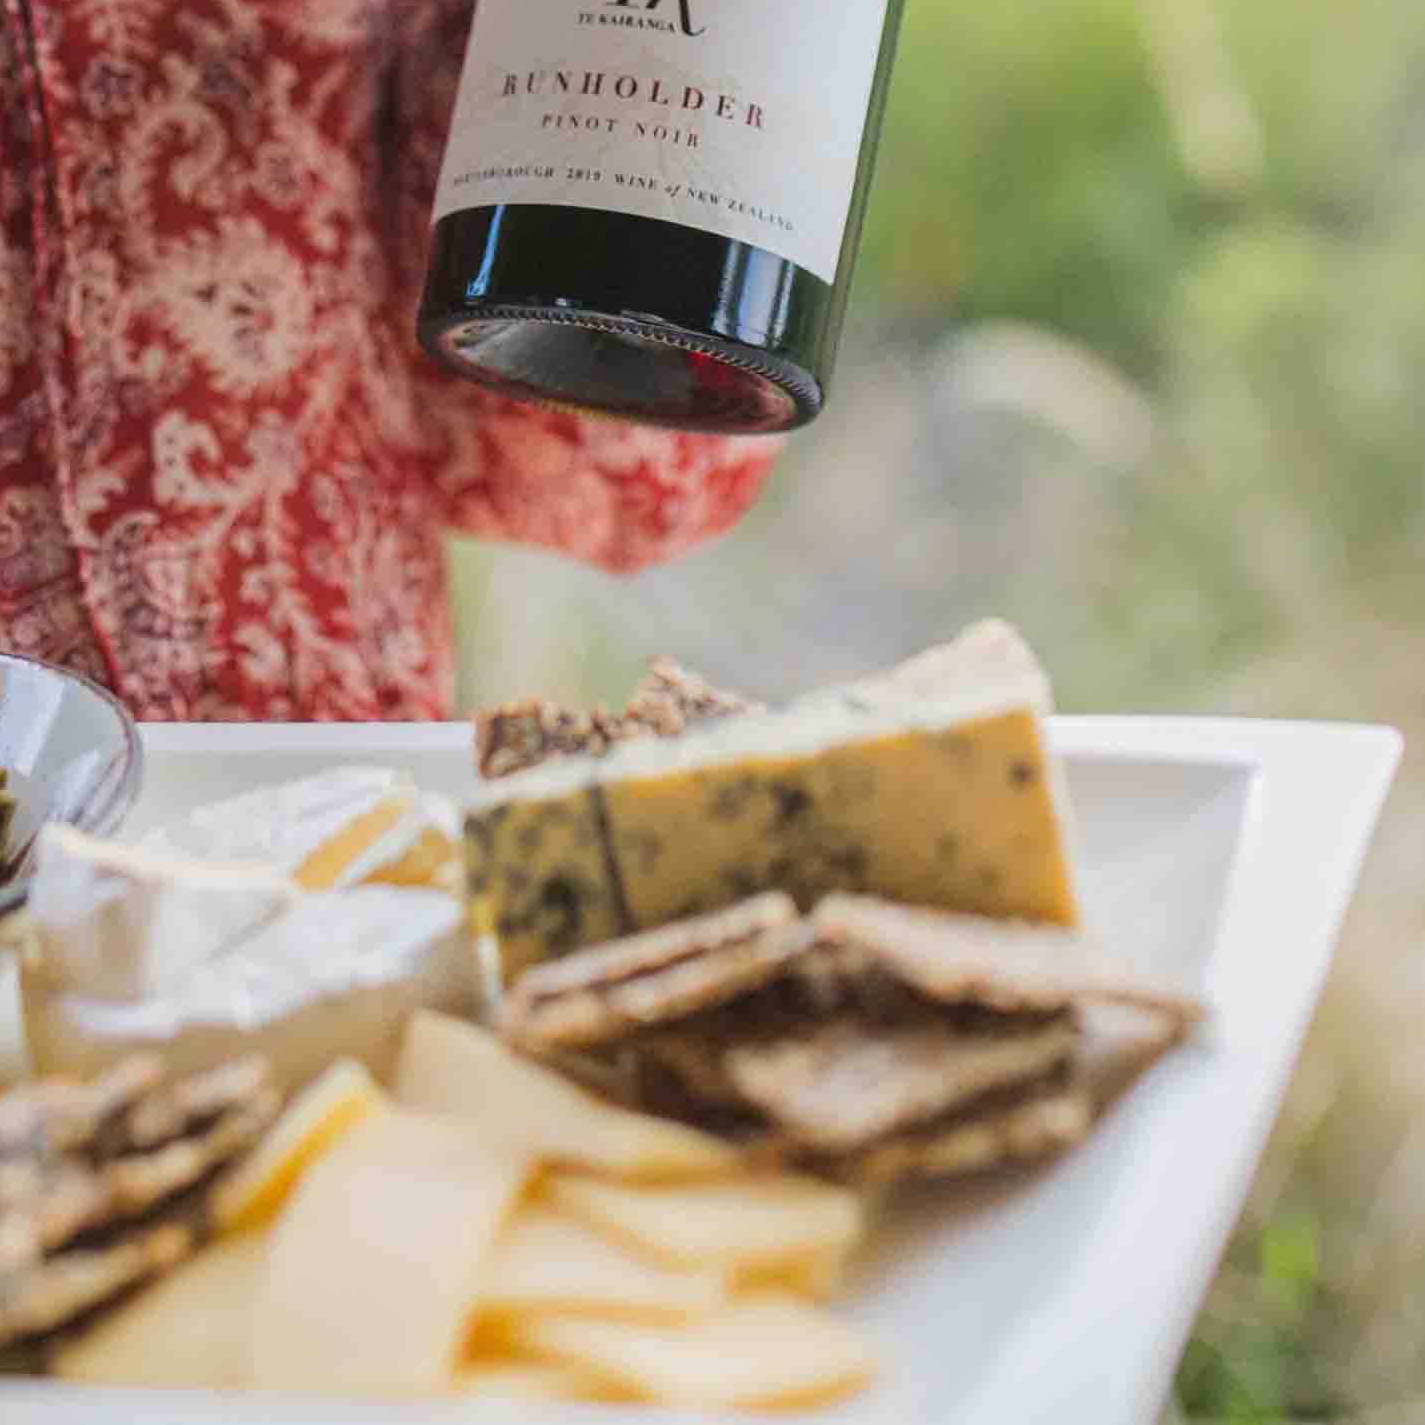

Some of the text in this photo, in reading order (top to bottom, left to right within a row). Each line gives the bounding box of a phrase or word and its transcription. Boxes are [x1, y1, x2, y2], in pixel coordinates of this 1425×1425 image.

[502, 70, 764, 129] RUNHOLDER
[541, 114, 700, 148] PINOT NOIR
[615, 173, 658, 191] WINE
[664, 185, 681, 198] of
[686, 187, 719, 205] NEW
